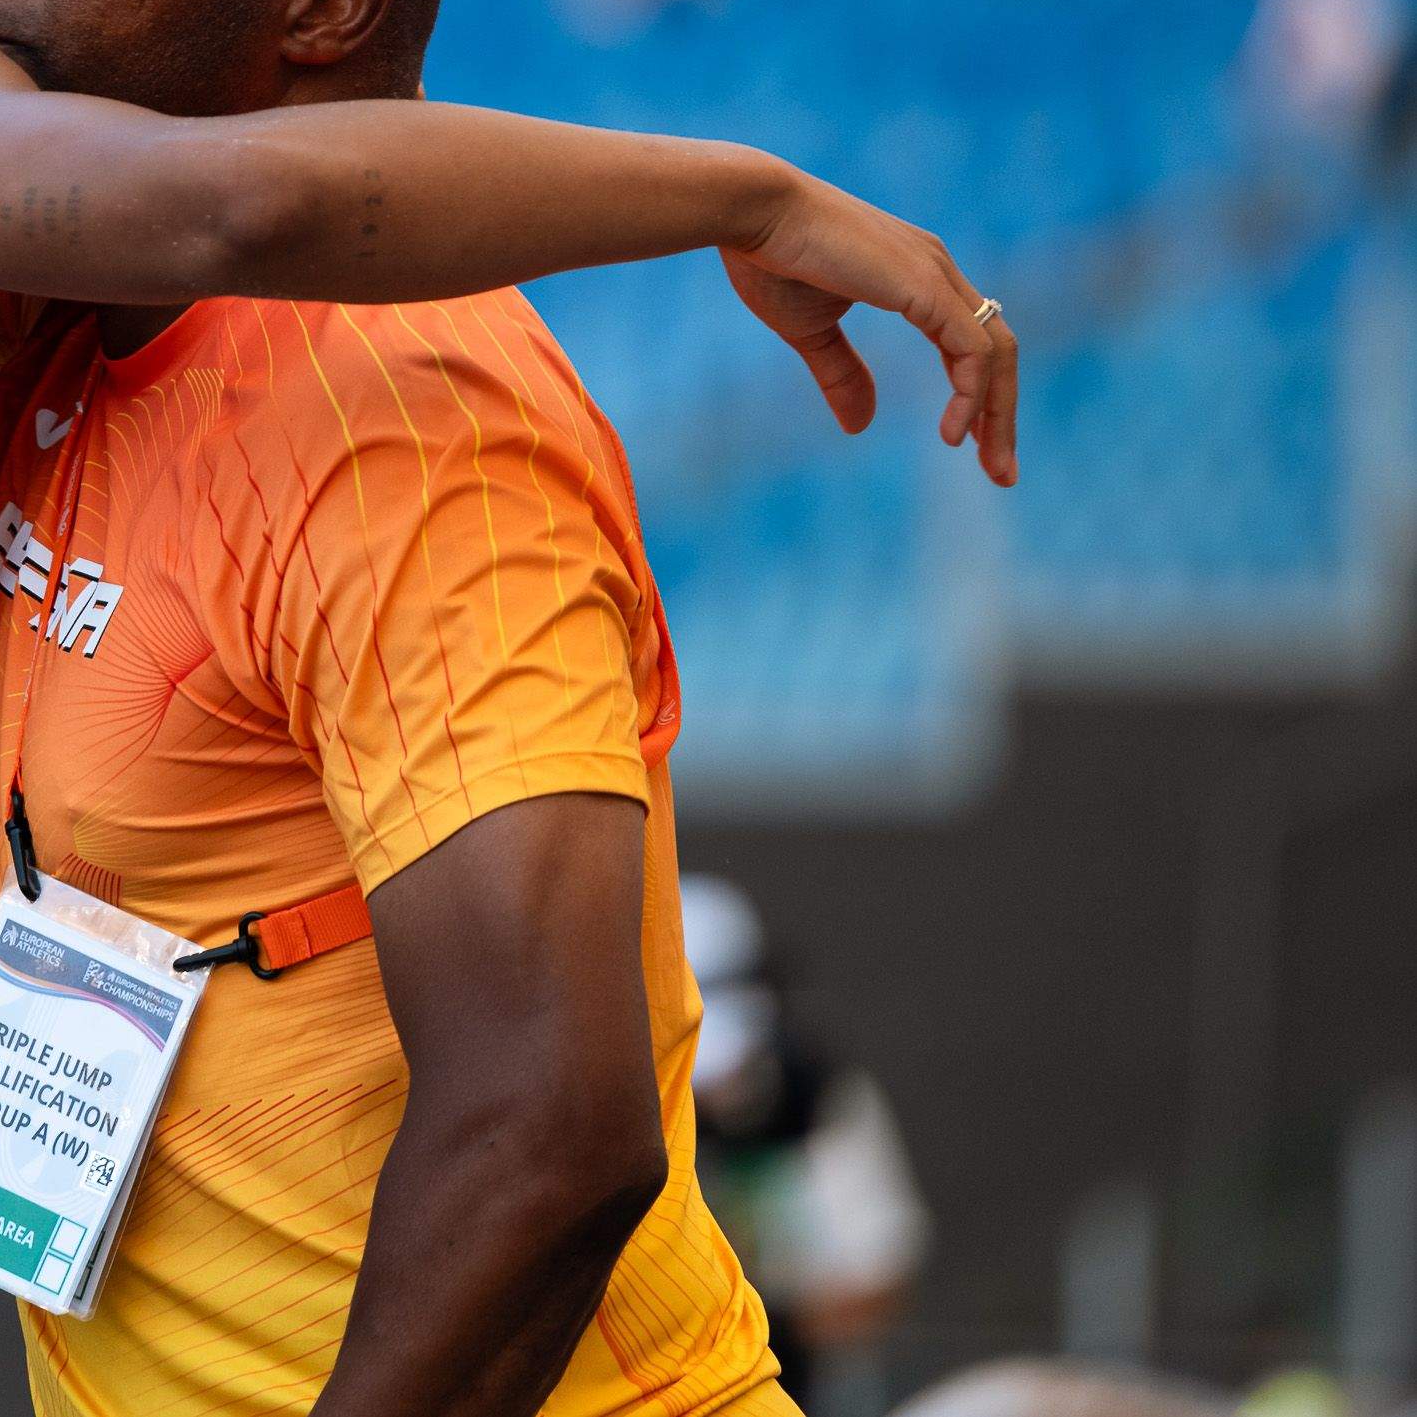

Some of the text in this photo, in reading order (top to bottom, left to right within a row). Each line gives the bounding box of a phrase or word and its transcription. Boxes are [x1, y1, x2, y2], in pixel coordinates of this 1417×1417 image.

[16, 941, 62, 967] ATHLETICS
[19, 930, 65, 958] EUROPEAN
[103, 982, 175, 1021] CHAMPIONSHIPS
[115, 975, 178, 1010] EUROPEAN ATHLETICS
[49, 1052, 112, 1091] JUMP
[31, 1122, 49, 1145] A
[52, 1131, 89, 1167] (W)
